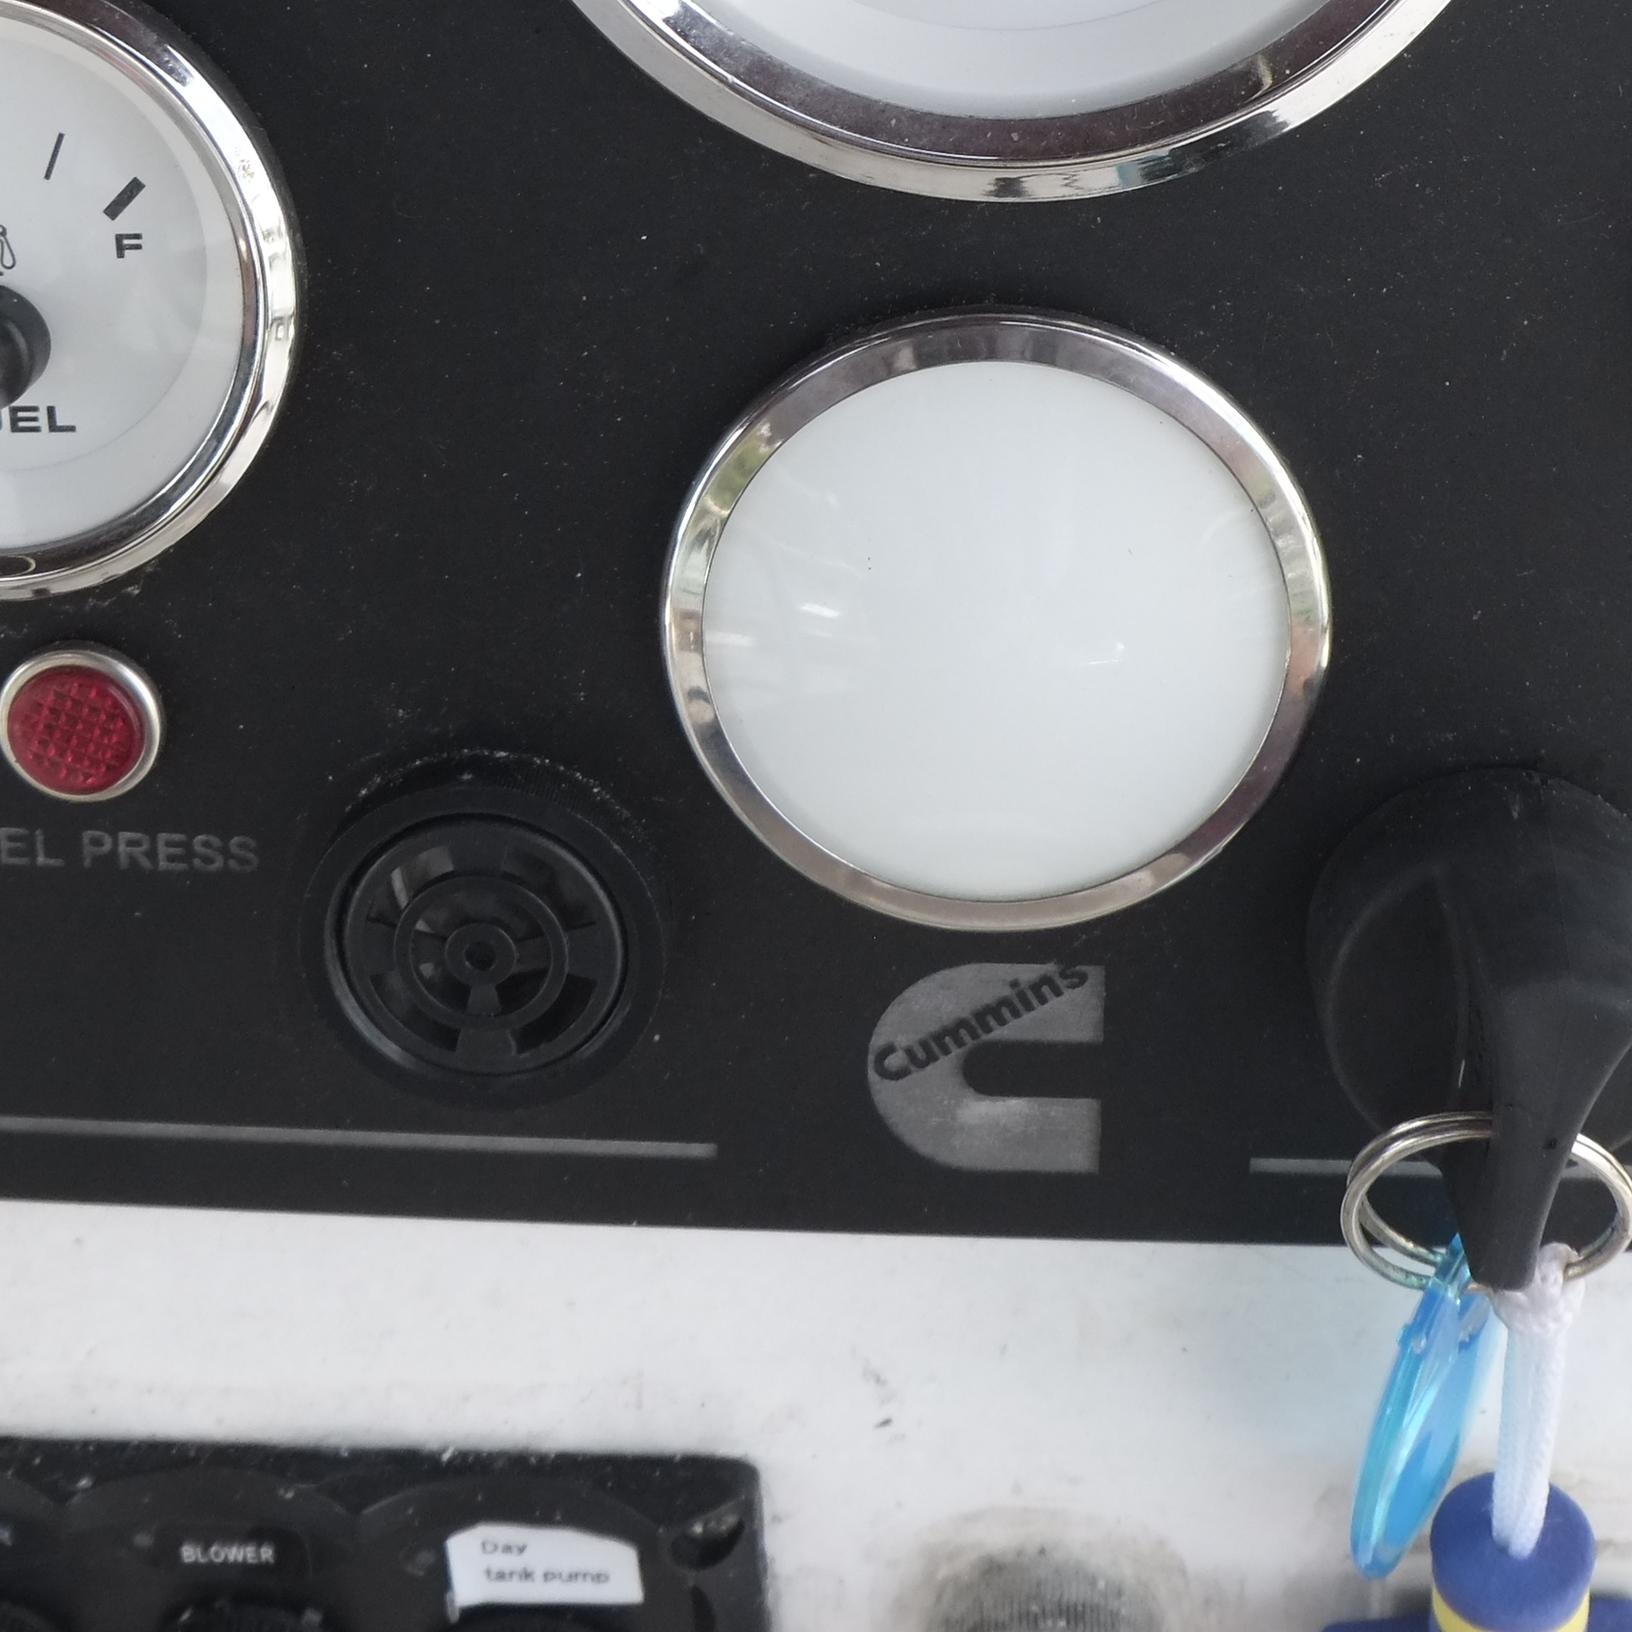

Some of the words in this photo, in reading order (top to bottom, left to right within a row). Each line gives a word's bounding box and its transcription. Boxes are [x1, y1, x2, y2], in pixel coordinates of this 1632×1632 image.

[115, 233, 142, 258] F
[82, 830, 260, 871] PRESS
[873, 966, 1089, 1082] Cummins
[180, 1542, 275, 1565] BLOWER
[480, 1540, 528, 1555] Day
[484, 1567, 536, 1583] tank
[542, 1570, 610, 1584] pump
